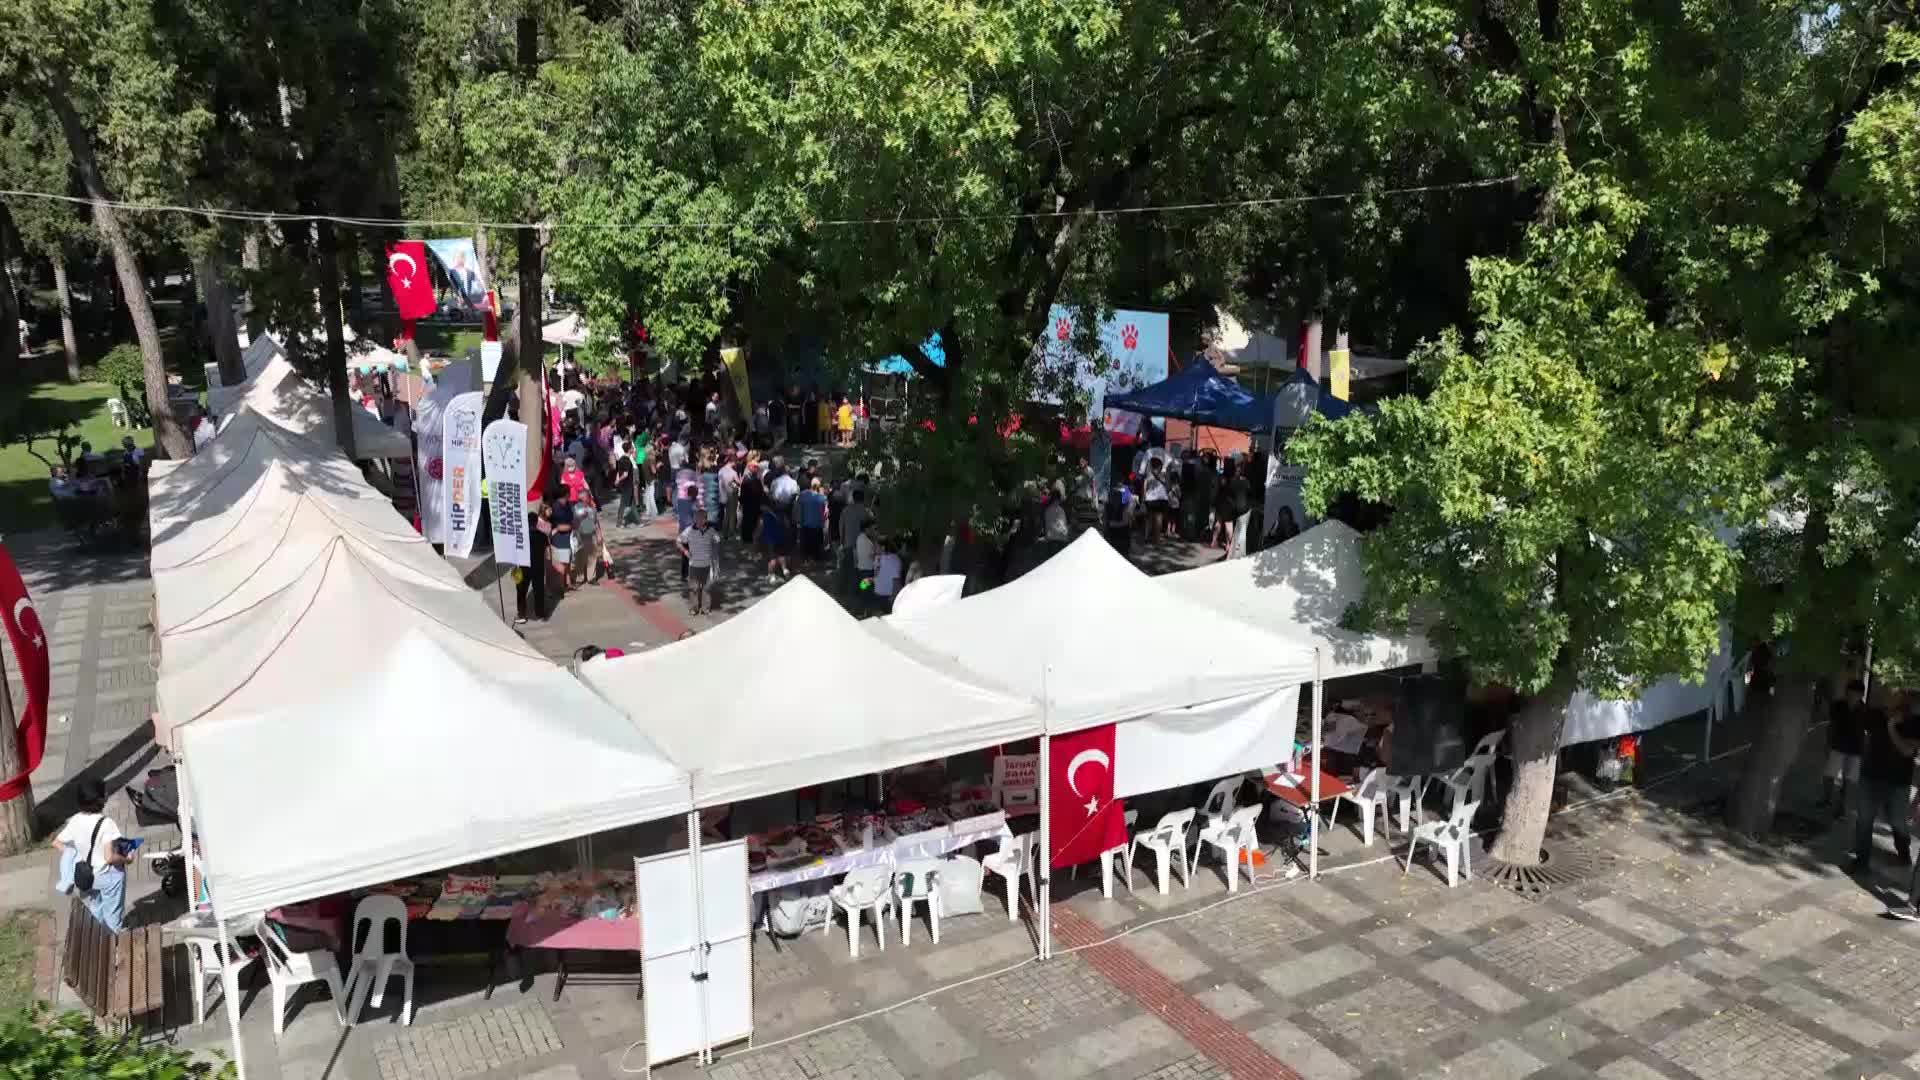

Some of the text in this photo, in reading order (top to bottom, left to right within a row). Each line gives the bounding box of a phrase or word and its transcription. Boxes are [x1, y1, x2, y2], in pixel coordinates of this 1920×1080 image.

[451, 467, 465, 531] HiPDER
[499, 482, 507, 534] HAYVAN
[507, 482, 516, 535] HAKLARI
